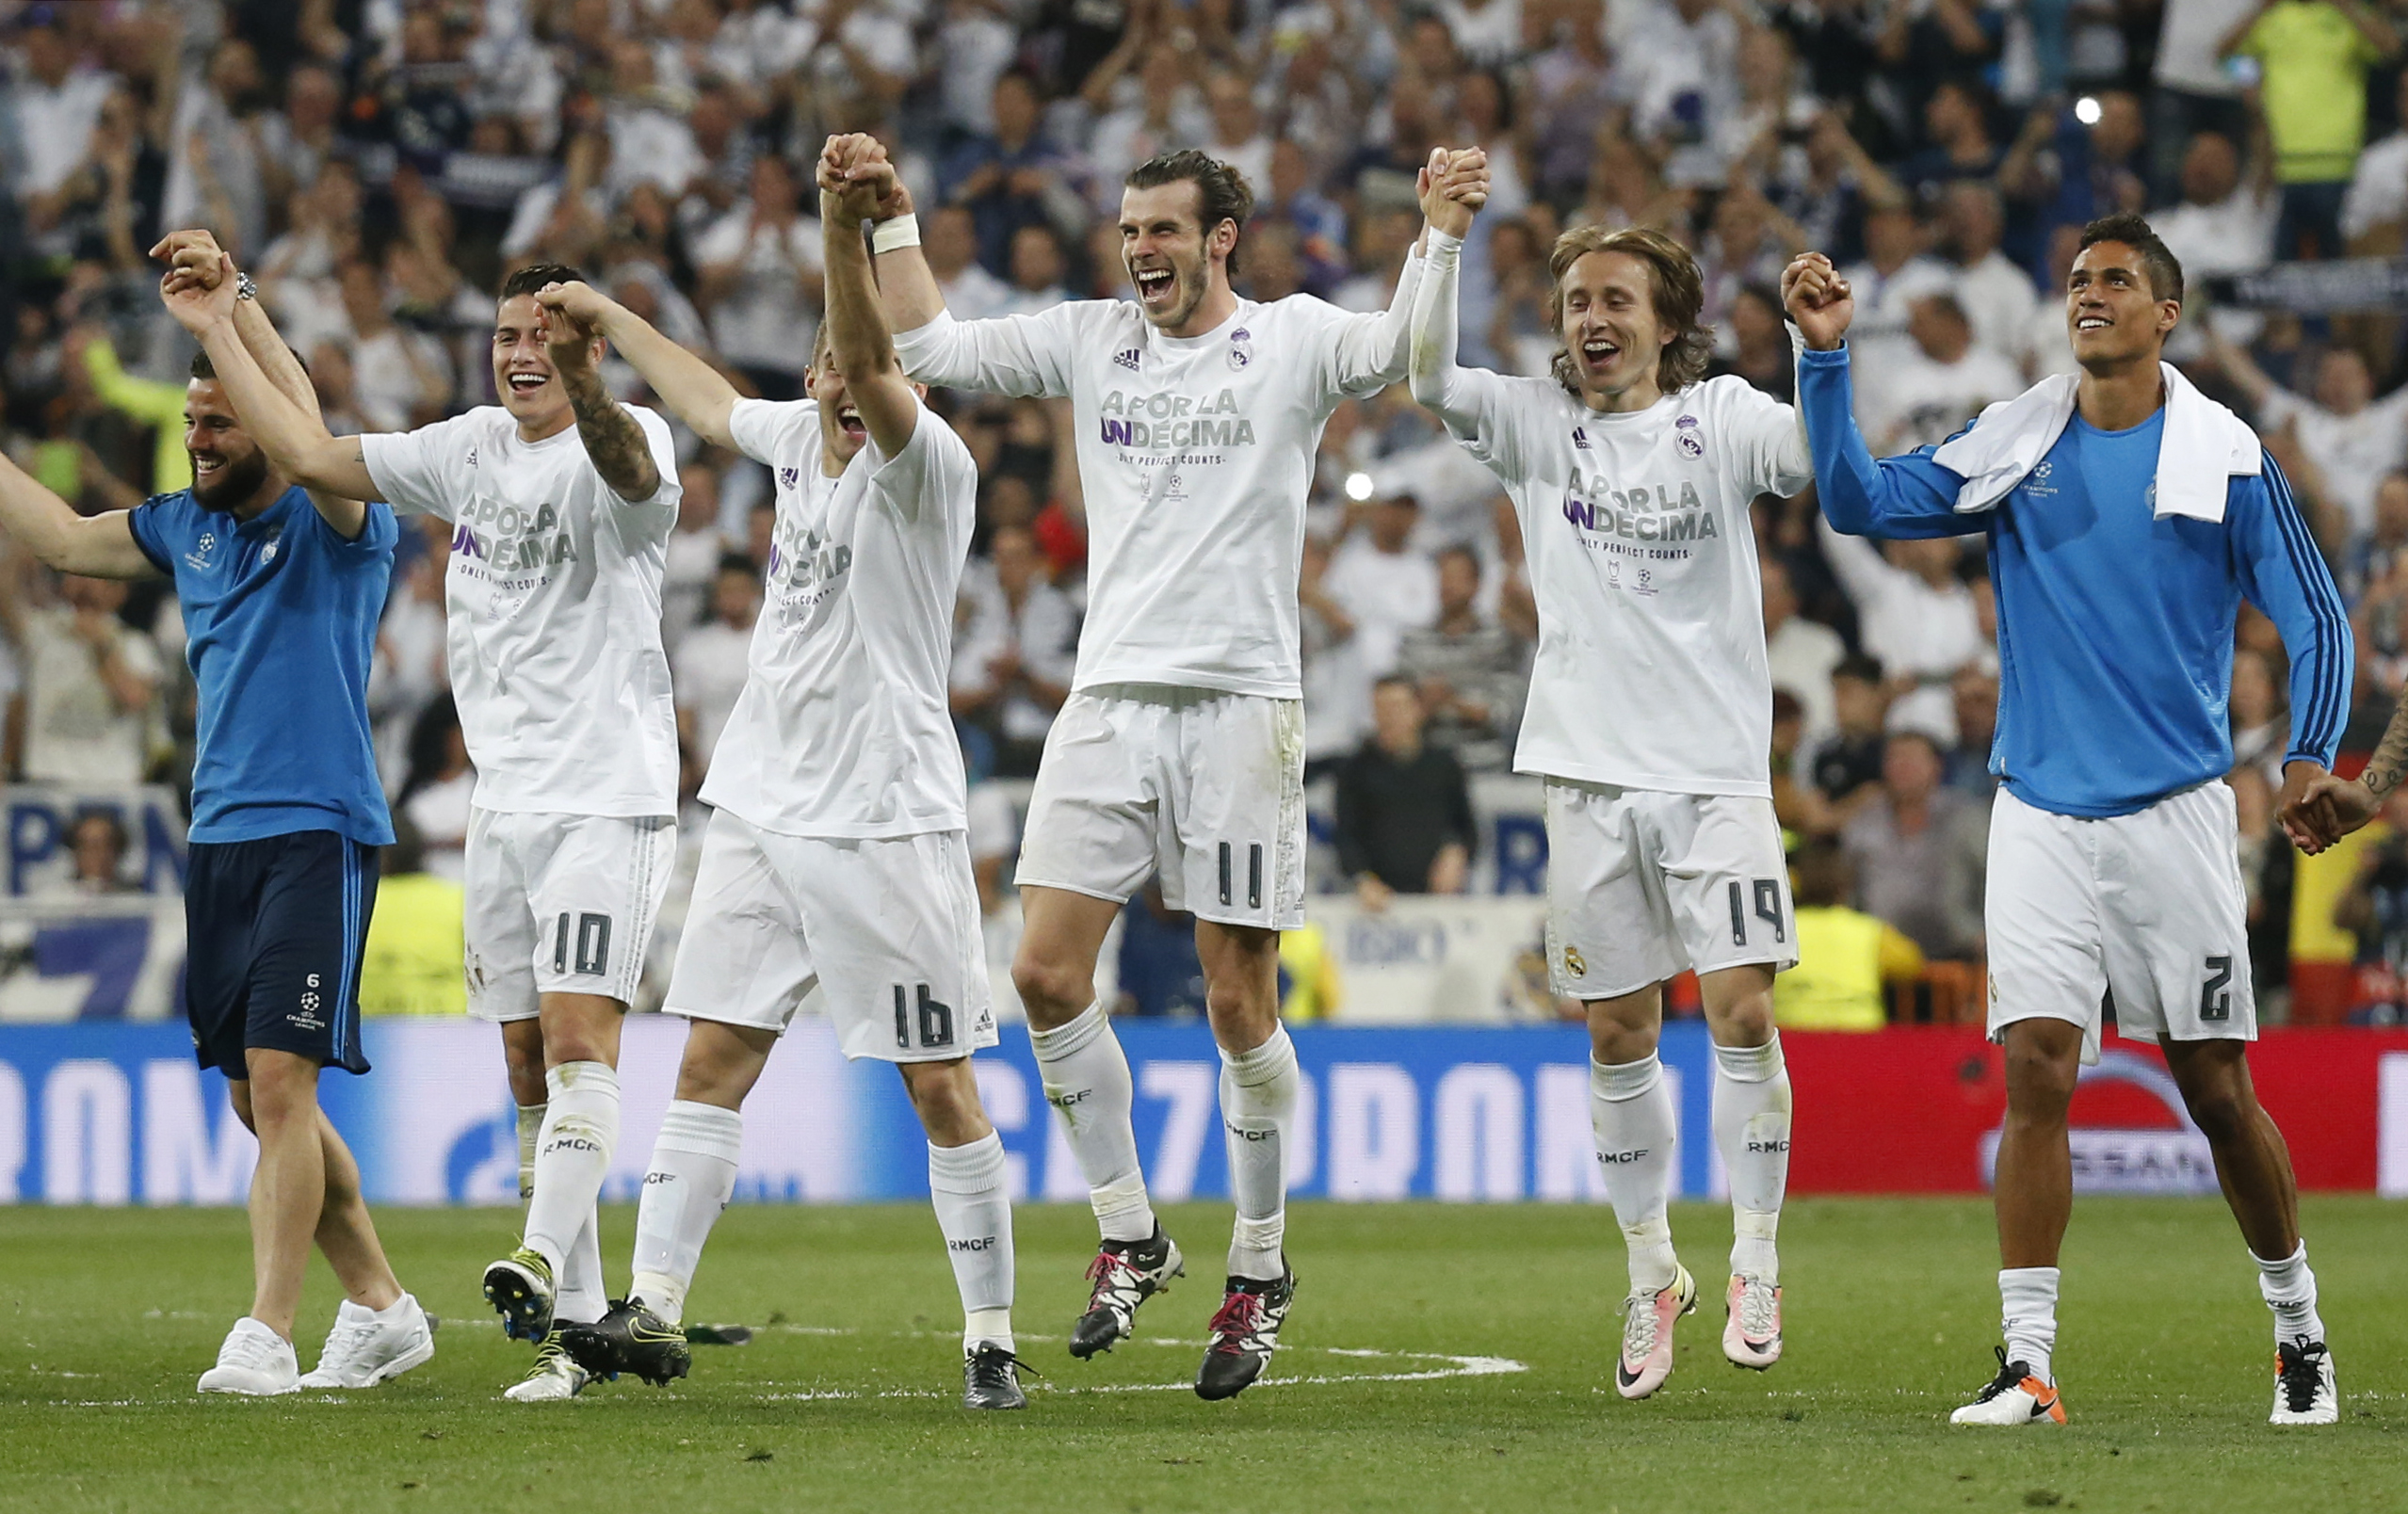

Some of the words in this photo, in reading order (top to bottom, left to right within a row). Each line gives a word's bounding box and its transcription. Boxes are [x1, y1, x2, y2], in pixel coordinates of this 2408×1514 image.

[1102, 391, 1123, 415] A
[1127, 393, 1192, 419] POR
[1196, 389, 1238, 414] LA
[1569, 467, 1584, 495] A
[1657, 482, 1702, 511] LA
[1219, 841, 1263, 909] 11
[1727, 878, 1785, 946] 19
[555, 911, 610, 976] 10
[307, 974, 320, 988] 6
[2200, 955, 2232, 1022] 2
[894, 984, 953, 1047] 16
[1047, 1088, 1091, 1106] MCF
[1225, 1119, 1278, 1141] RMCF
[542, 1138, 602, 1157] RMCF
[1748, 1141, 1789, 1153] RMC
[949, 1236, 995, 1251] RMCF
